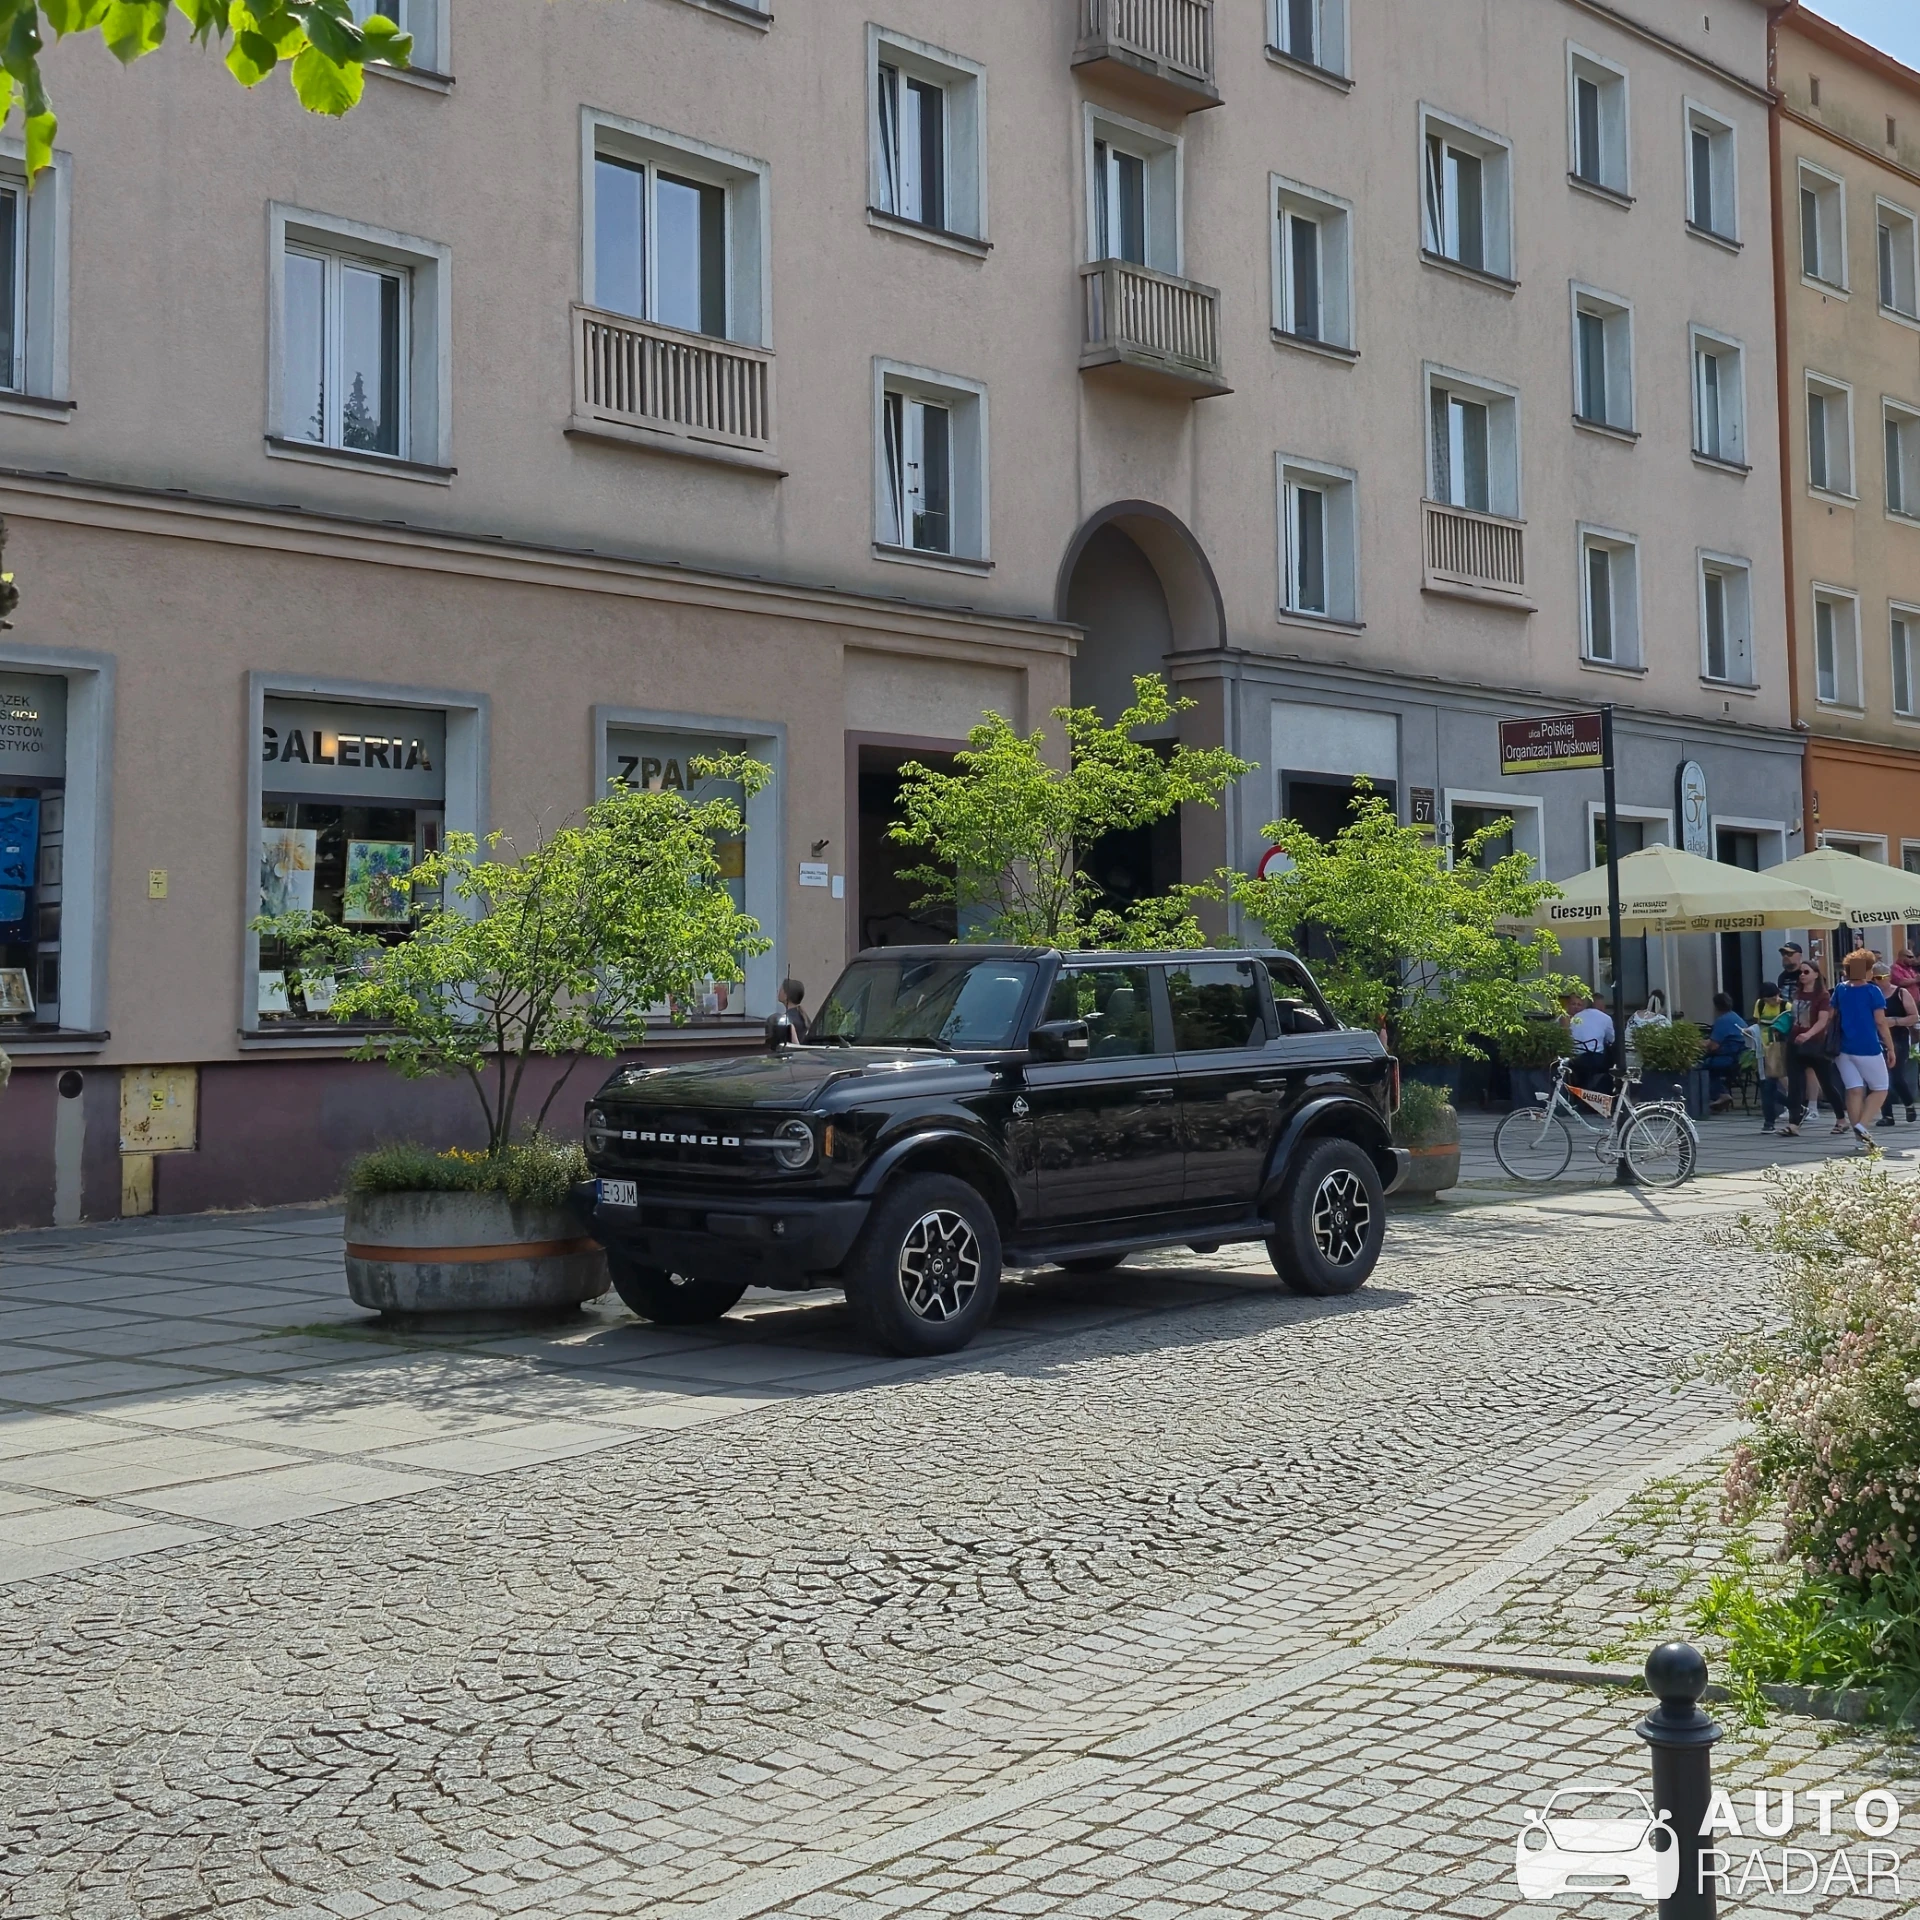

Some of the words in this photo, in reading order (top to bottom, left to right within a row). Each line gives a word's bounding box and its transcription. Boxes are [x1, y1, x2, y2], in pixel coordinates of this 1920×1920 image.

[1528, 730, 1541, 739] ulica
[1541, 721, 1575, 738] Polskiej
[262, 726, 433, 771] GALERIA
[1506, 741, 1552, 761] Organizacji
[1554, 737, 1600, 758] Wojskowej
[1415, 801, 1430, 821] 57
[1551, 905, 1602, 919] Cieszyn
[1850, 910, 1900, 924] Cieszyn
[622, 1130, 740, 1147] BRONCO
